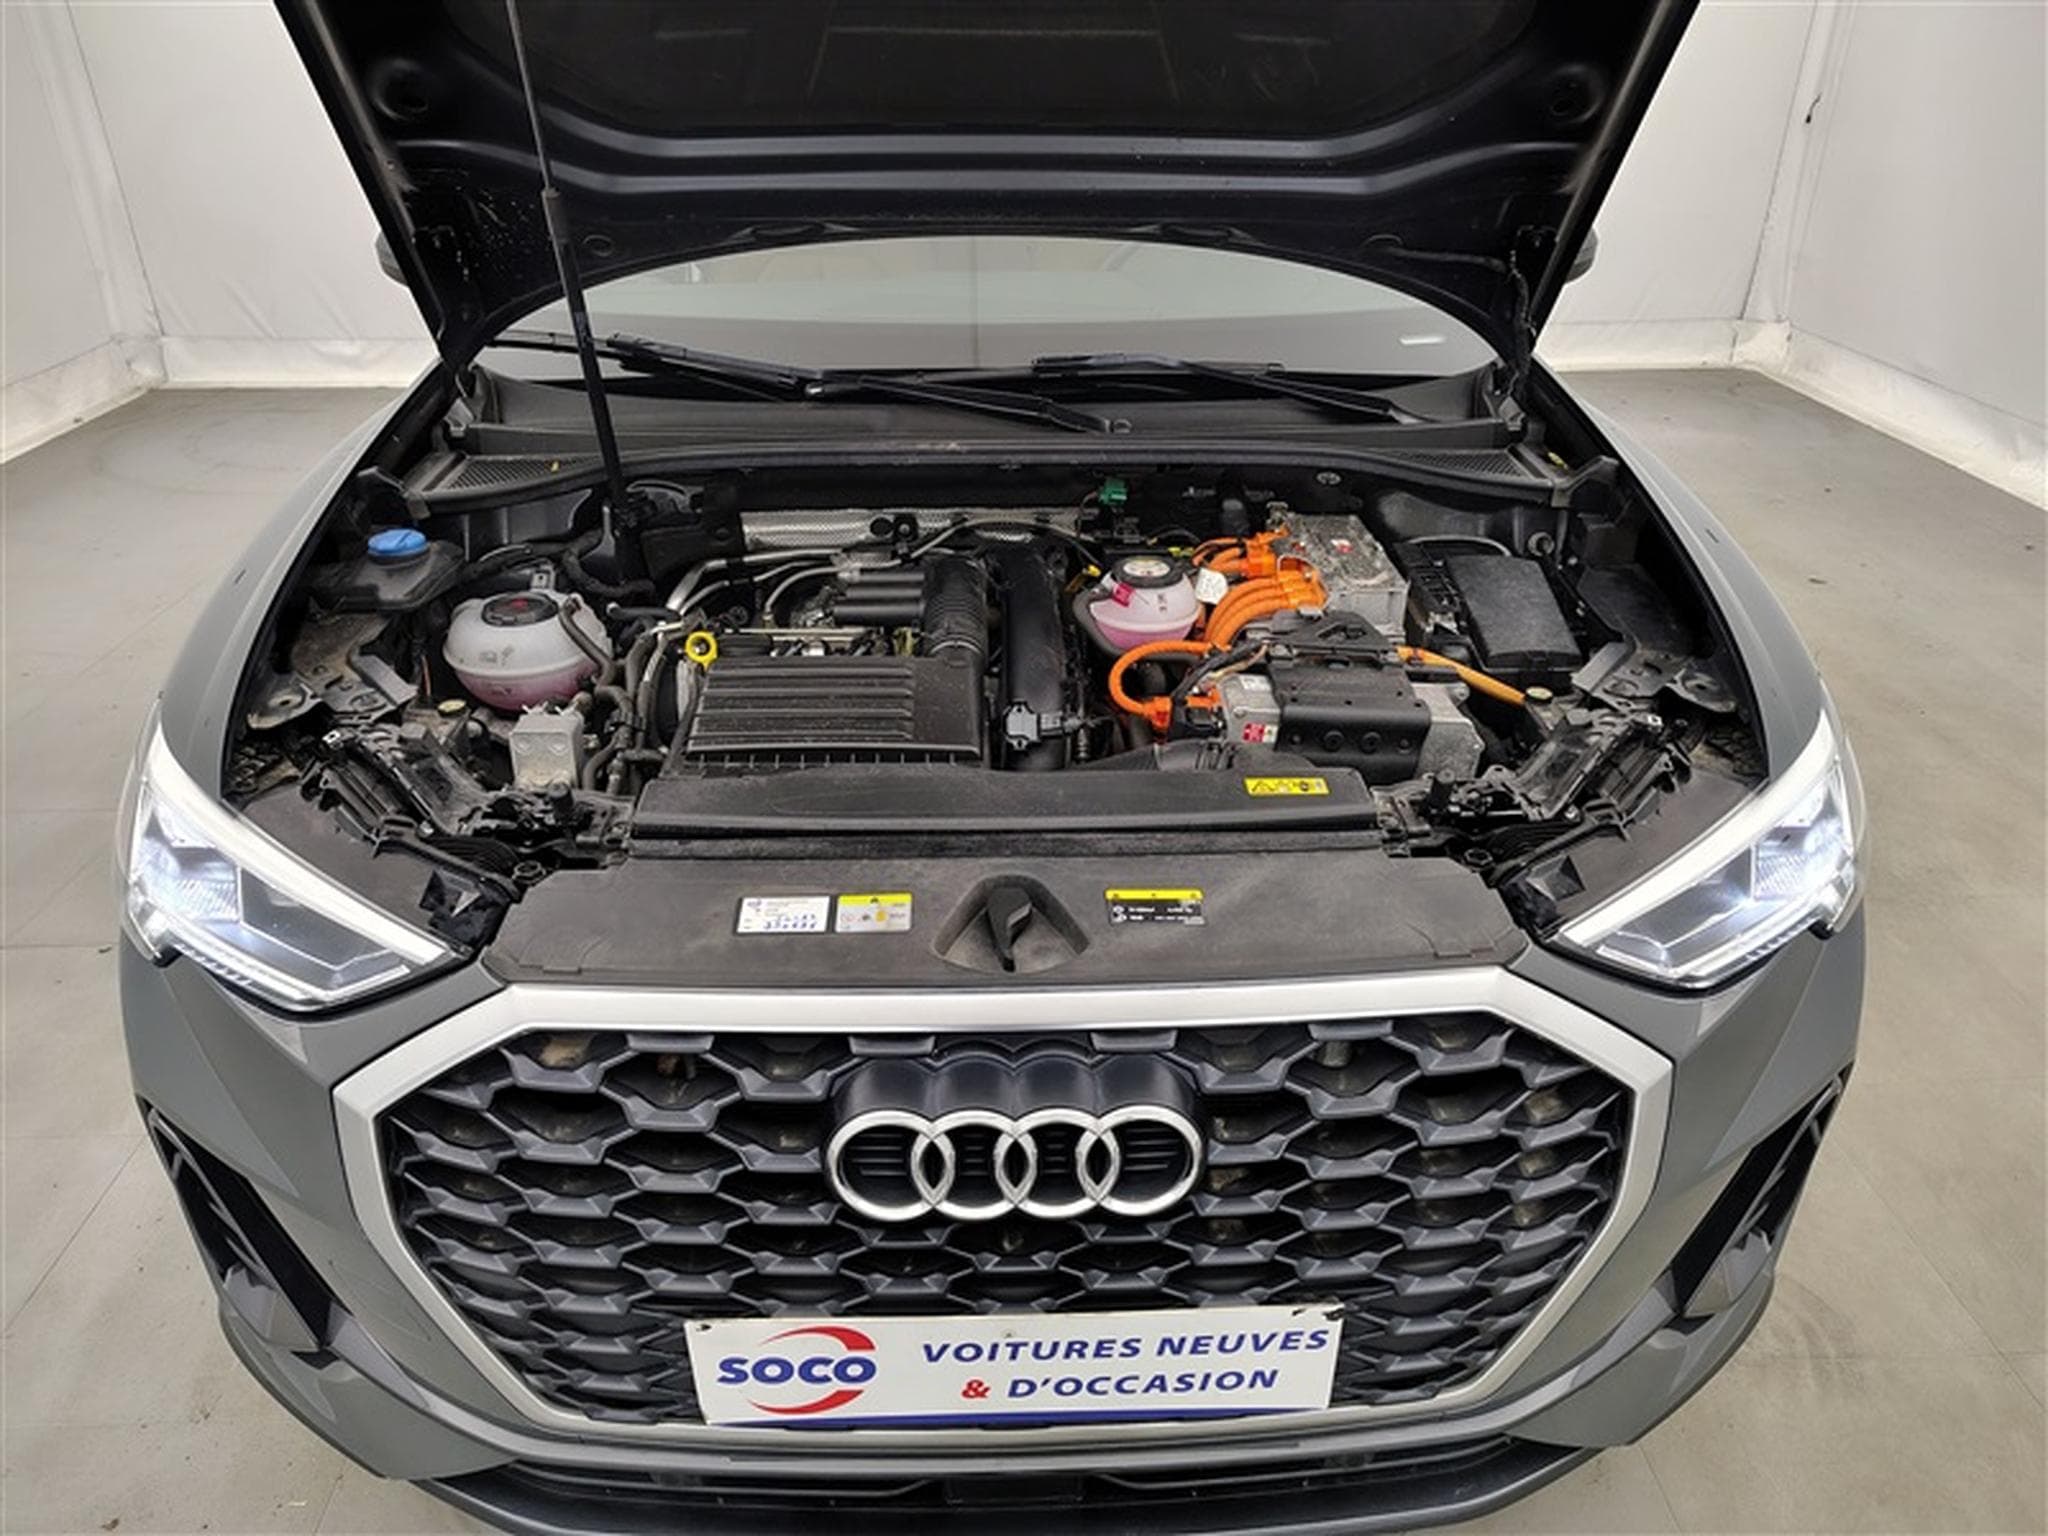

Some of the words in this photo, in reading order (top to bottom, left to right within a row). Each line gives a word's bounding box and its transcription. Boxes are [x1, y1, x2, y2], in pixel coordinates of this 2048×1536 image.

[923, 1337, 1142, 1363] VOITURES
[1155, 1329, 1329, 1357] NEUVES
[717, 1356, 876, 1385] SOCO
[961, 1378, 989, 1399] &
[1007, 1368, 1279, 1399] D'OCCASION
